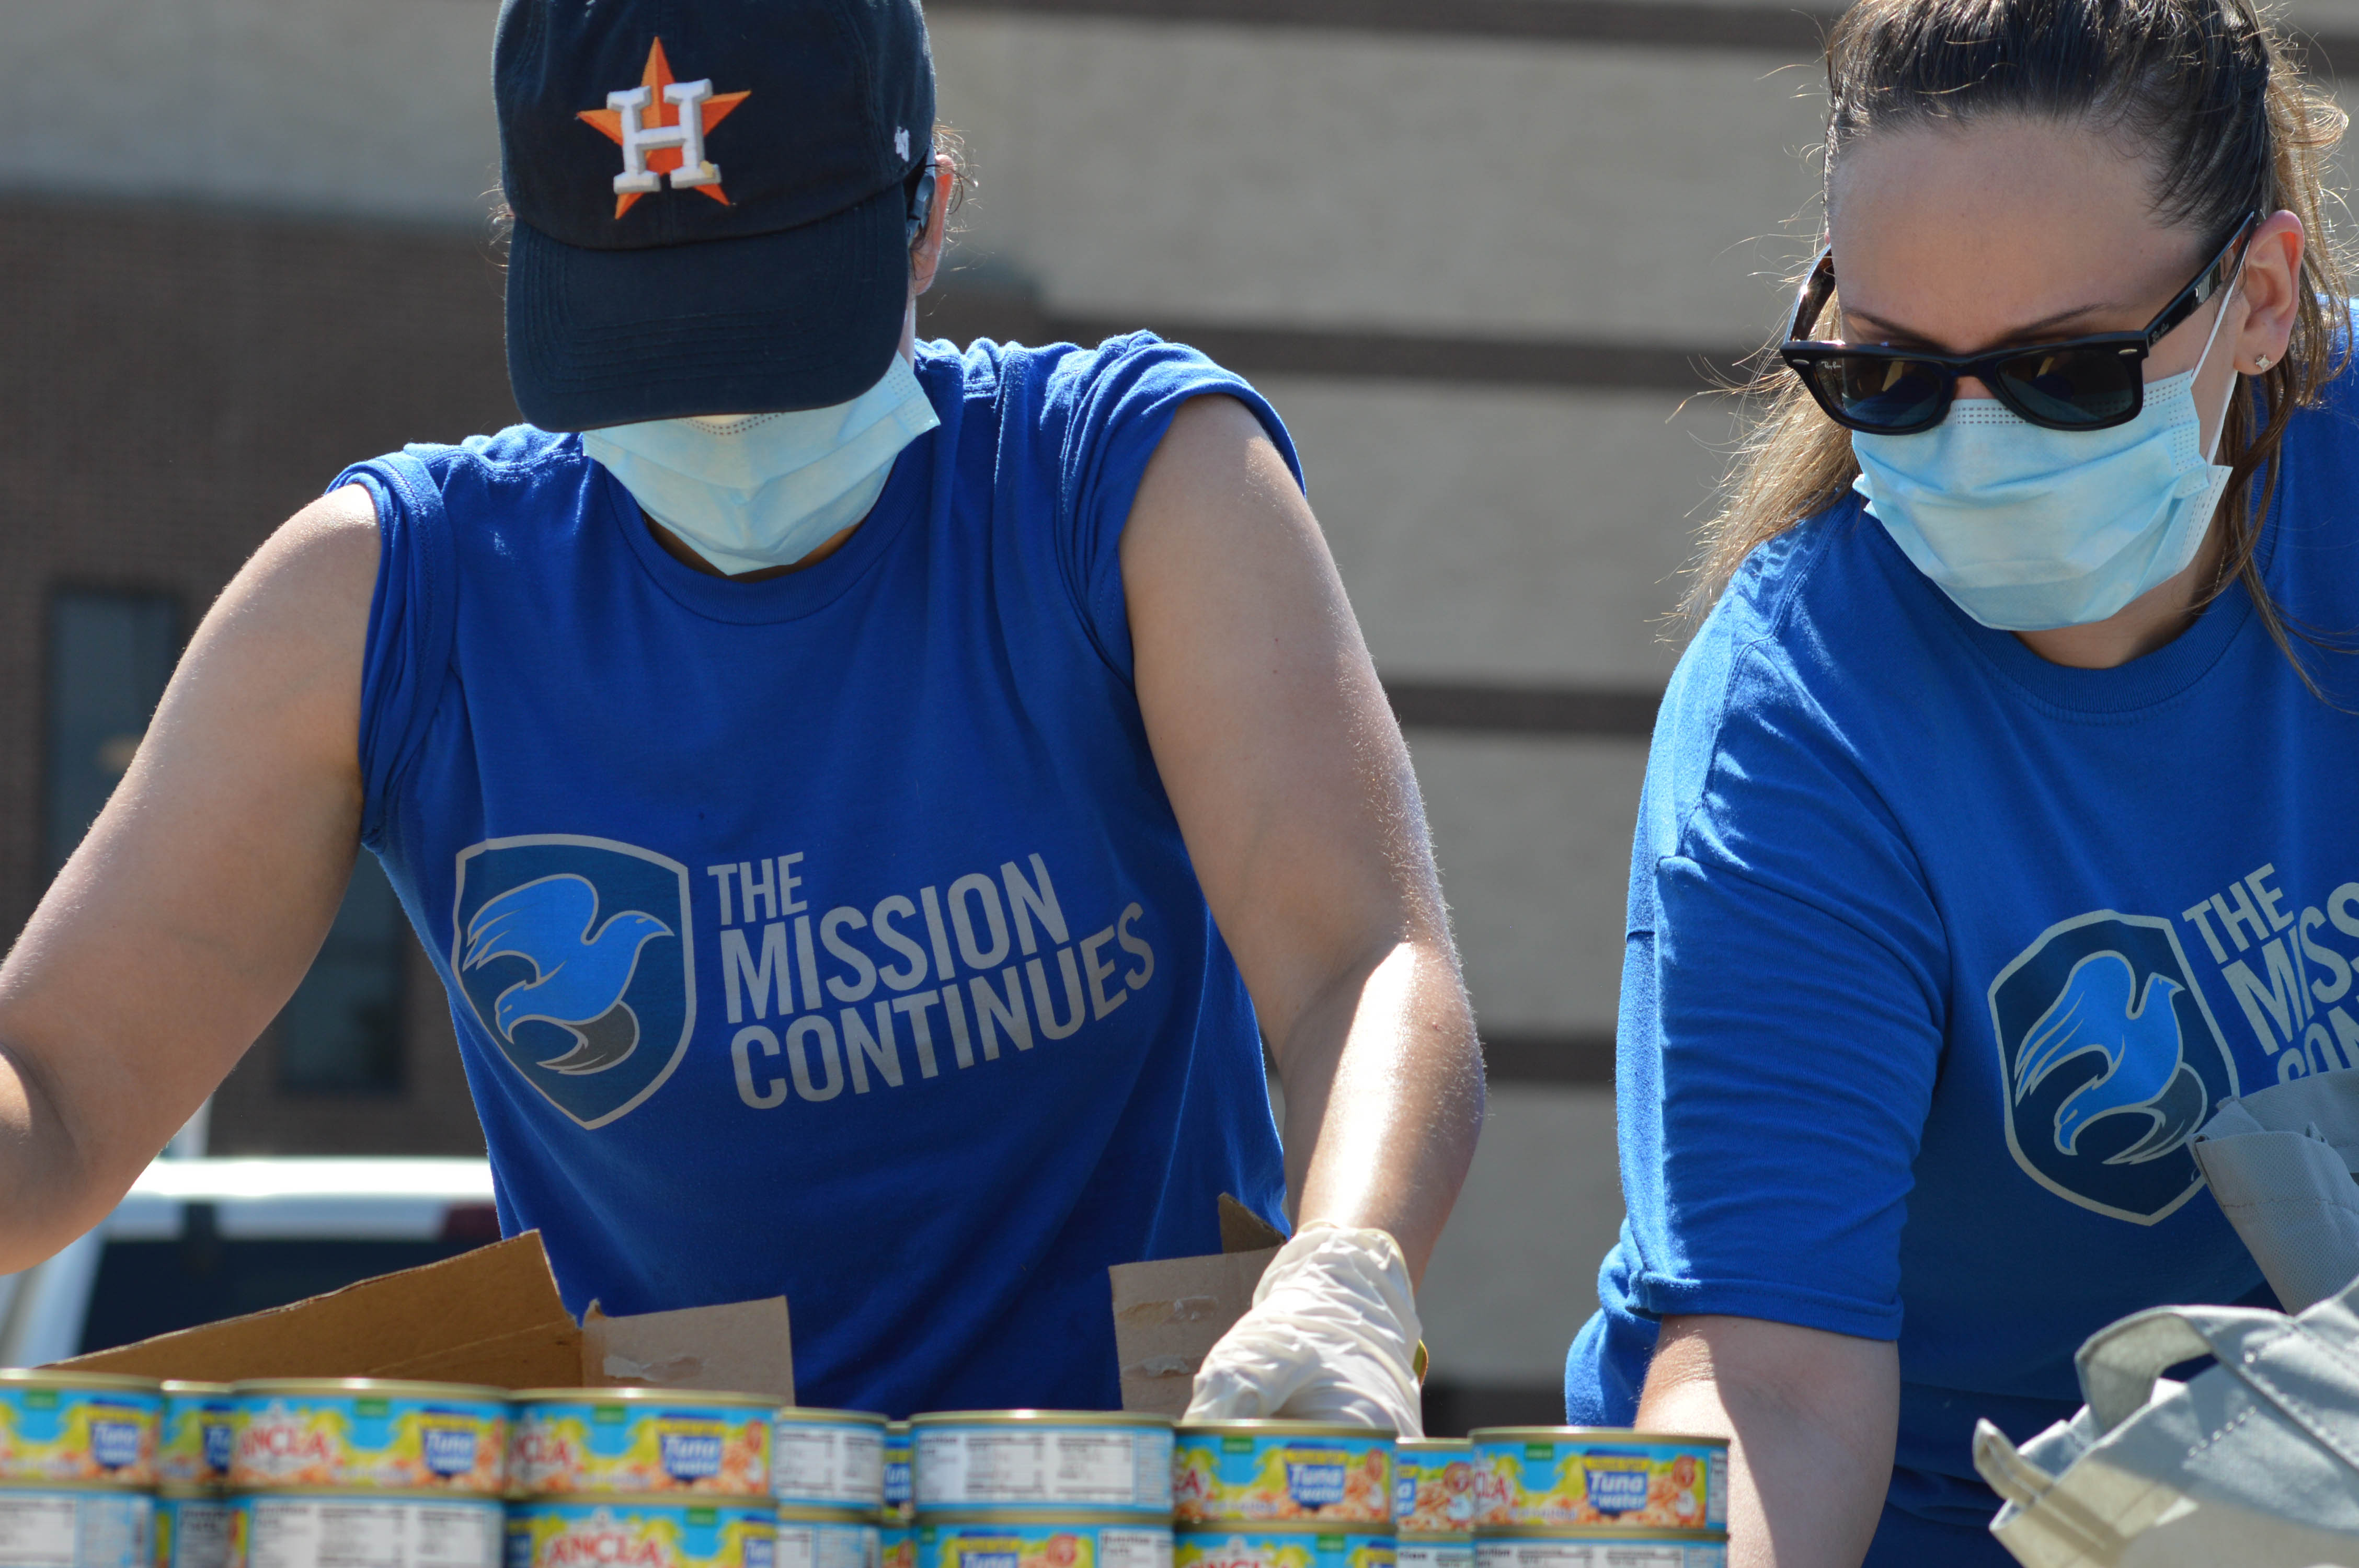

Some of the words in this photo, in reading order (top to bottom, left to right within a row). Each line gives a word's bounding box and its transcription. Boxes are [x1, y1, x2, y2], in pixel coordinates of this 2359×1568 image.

[606, 78, 721, 194] H
[707, 851, 808, 925] THE
[720, 852, 1070, 1023] MISSION
[2181, 862, 2295, 964] THE
[731, 902, 1154, 1109] CONTINUES
[1589, 1470, 1645, 1494] Tuna
[1597, 1493, 1645, 1509] water
